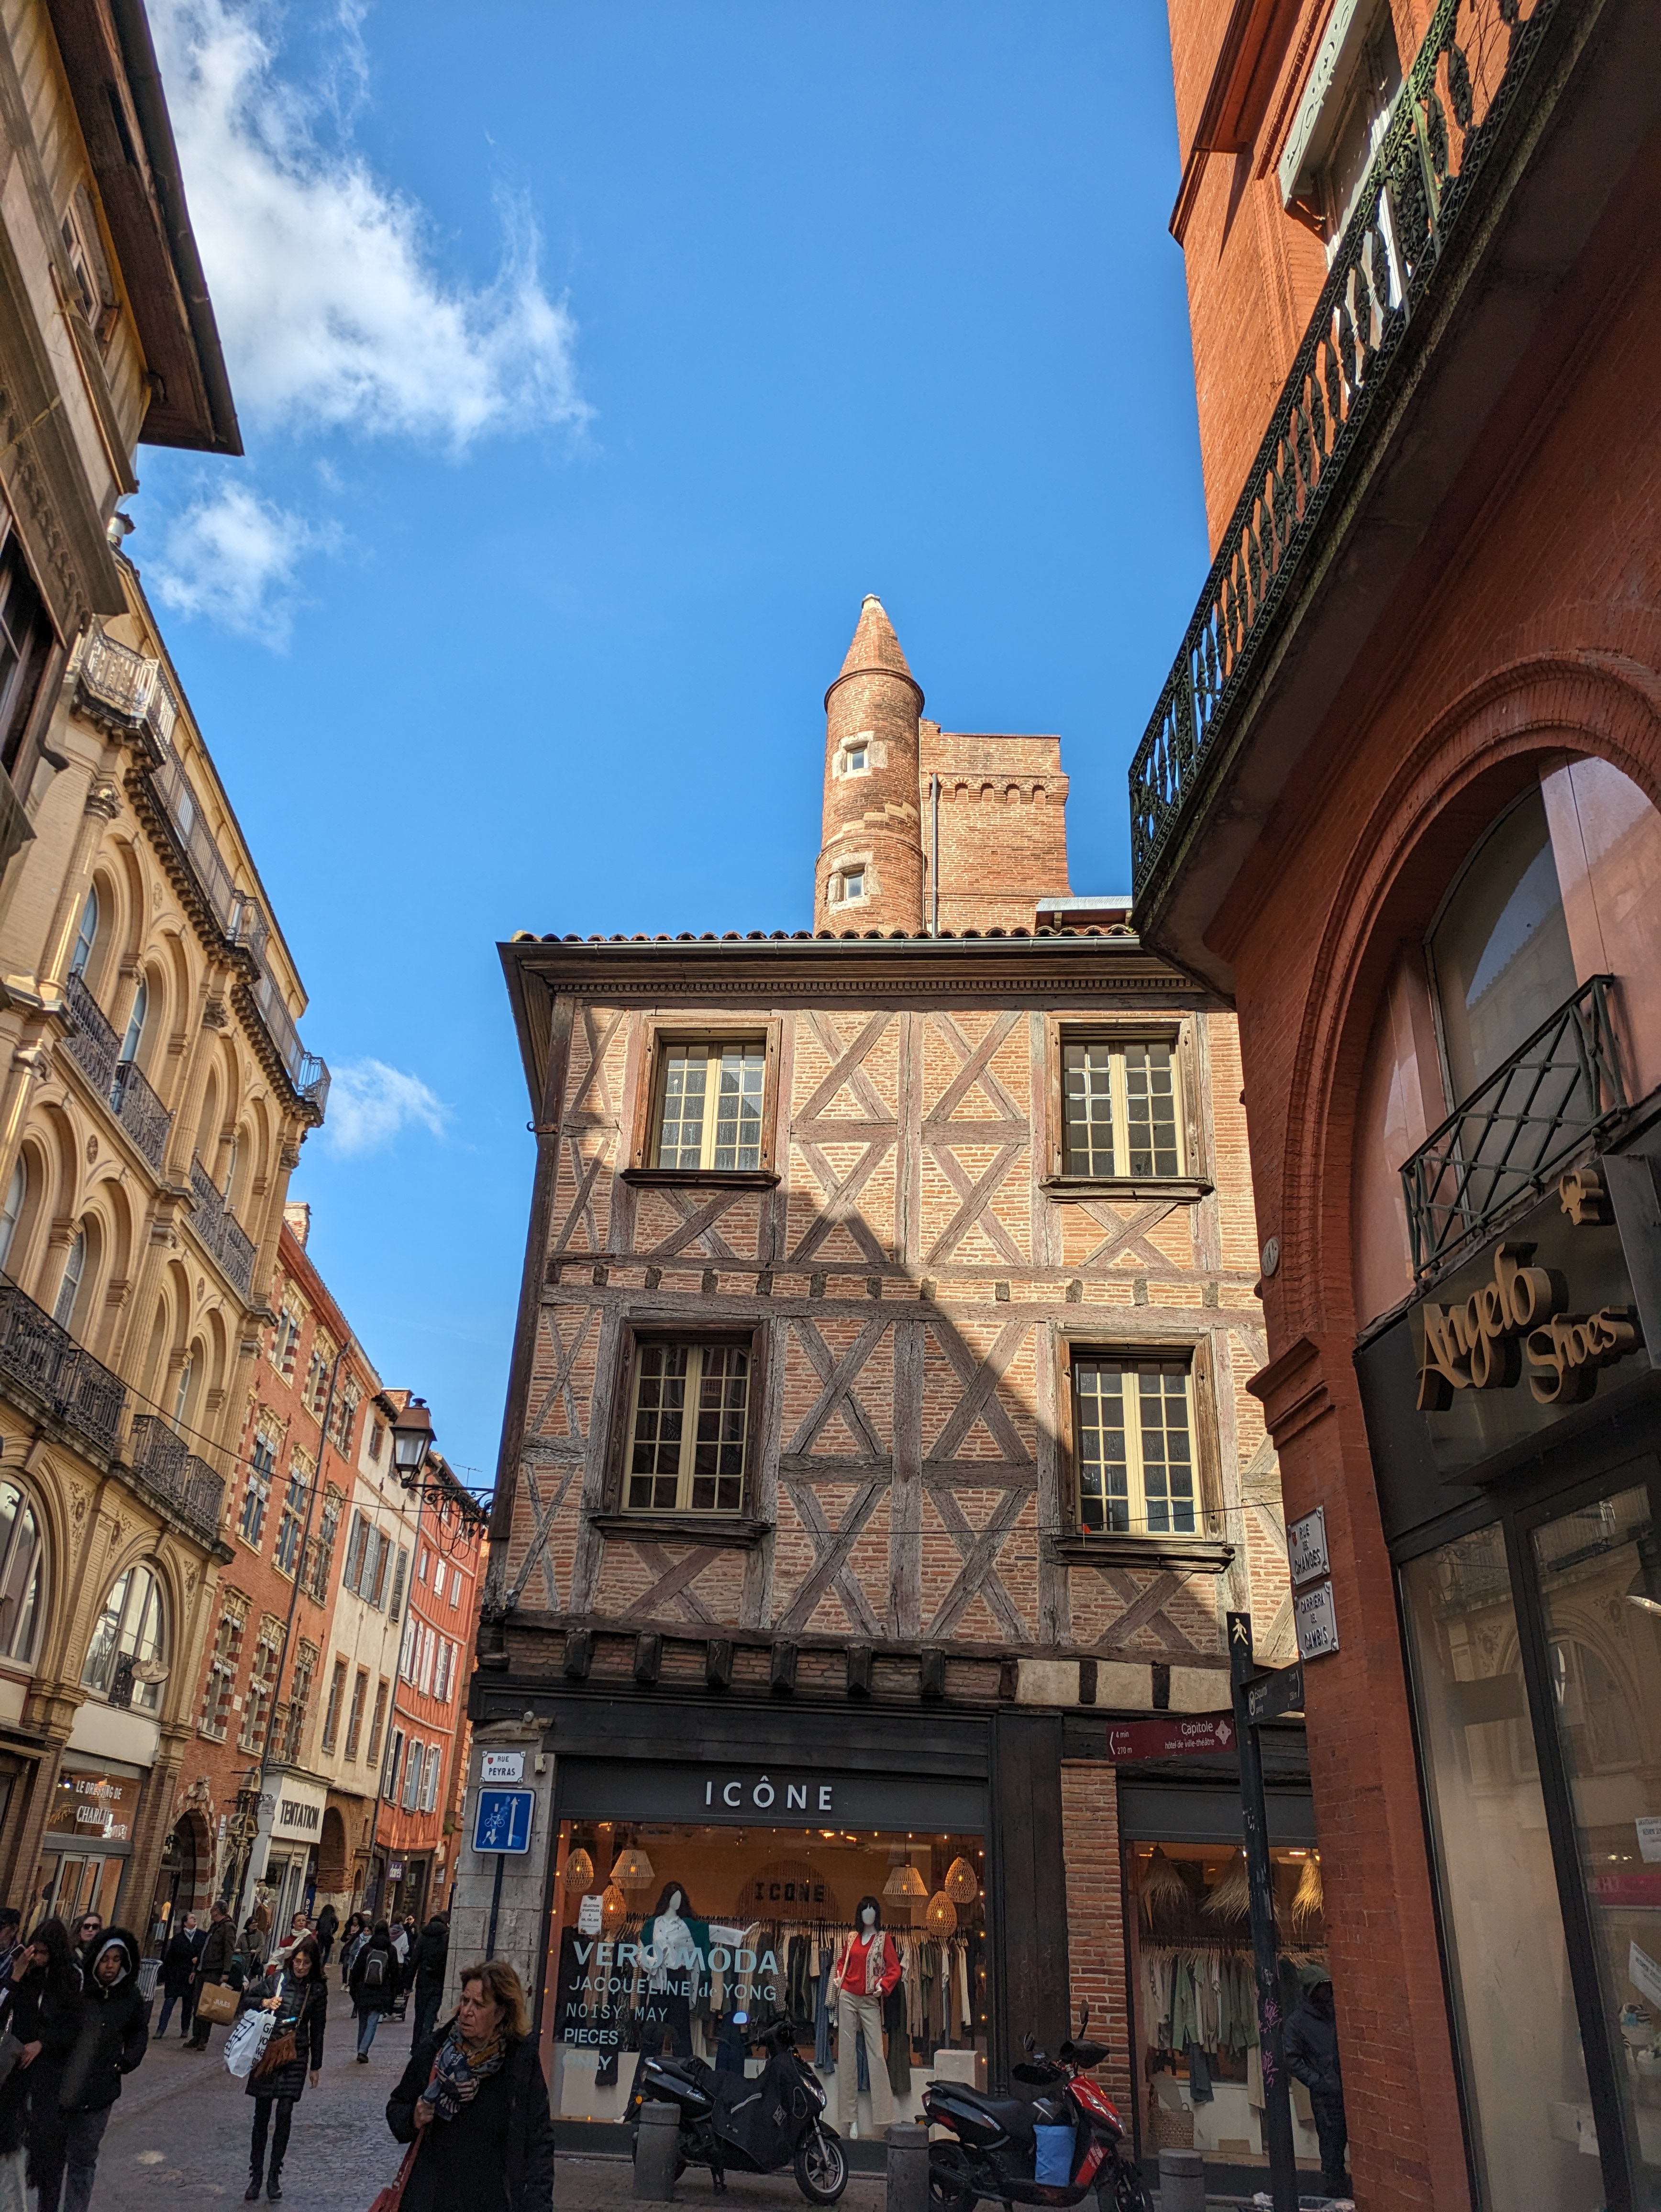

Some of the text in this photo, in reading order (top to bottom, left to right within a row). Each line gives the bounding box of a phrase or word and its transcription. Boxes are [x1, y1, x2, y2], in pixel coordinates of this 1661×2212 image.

[1416, 1242, 1634, 1411] Angelo Shoes
[1299, 1523, 1310, 1540] RUE
[1295, 1548, 1321, 1574] CHANGES
[1301, 1592, 1325, 1614] CARRIÈRA
[1305, 1625, 1328, 1650] CAMBIS
[1181, 1721, 1213, 1736] Capitole
[1165, 1738, 1215, 1749] hôtel de ville-théâtre
[488, 1768, 516, 1776] PEYRAS
[76, 1780, 122, 1800] LE DRESSING DE
[706, 1775, 832, 1811] ICÔNE
[280, 1799, 320, 1830] TENTATION
[755, 1882, 825, 1902] ICONE
[573, 1941, 779, 1975] VERO MODA
[569, 1976, 777, 2001] JACQUELINE de YONG
[214, 1999, 231, 2008] JULES
[566, 2003, 668, 2022] NOISY MAY
[564, 2028, 619, 2046] PIECES
